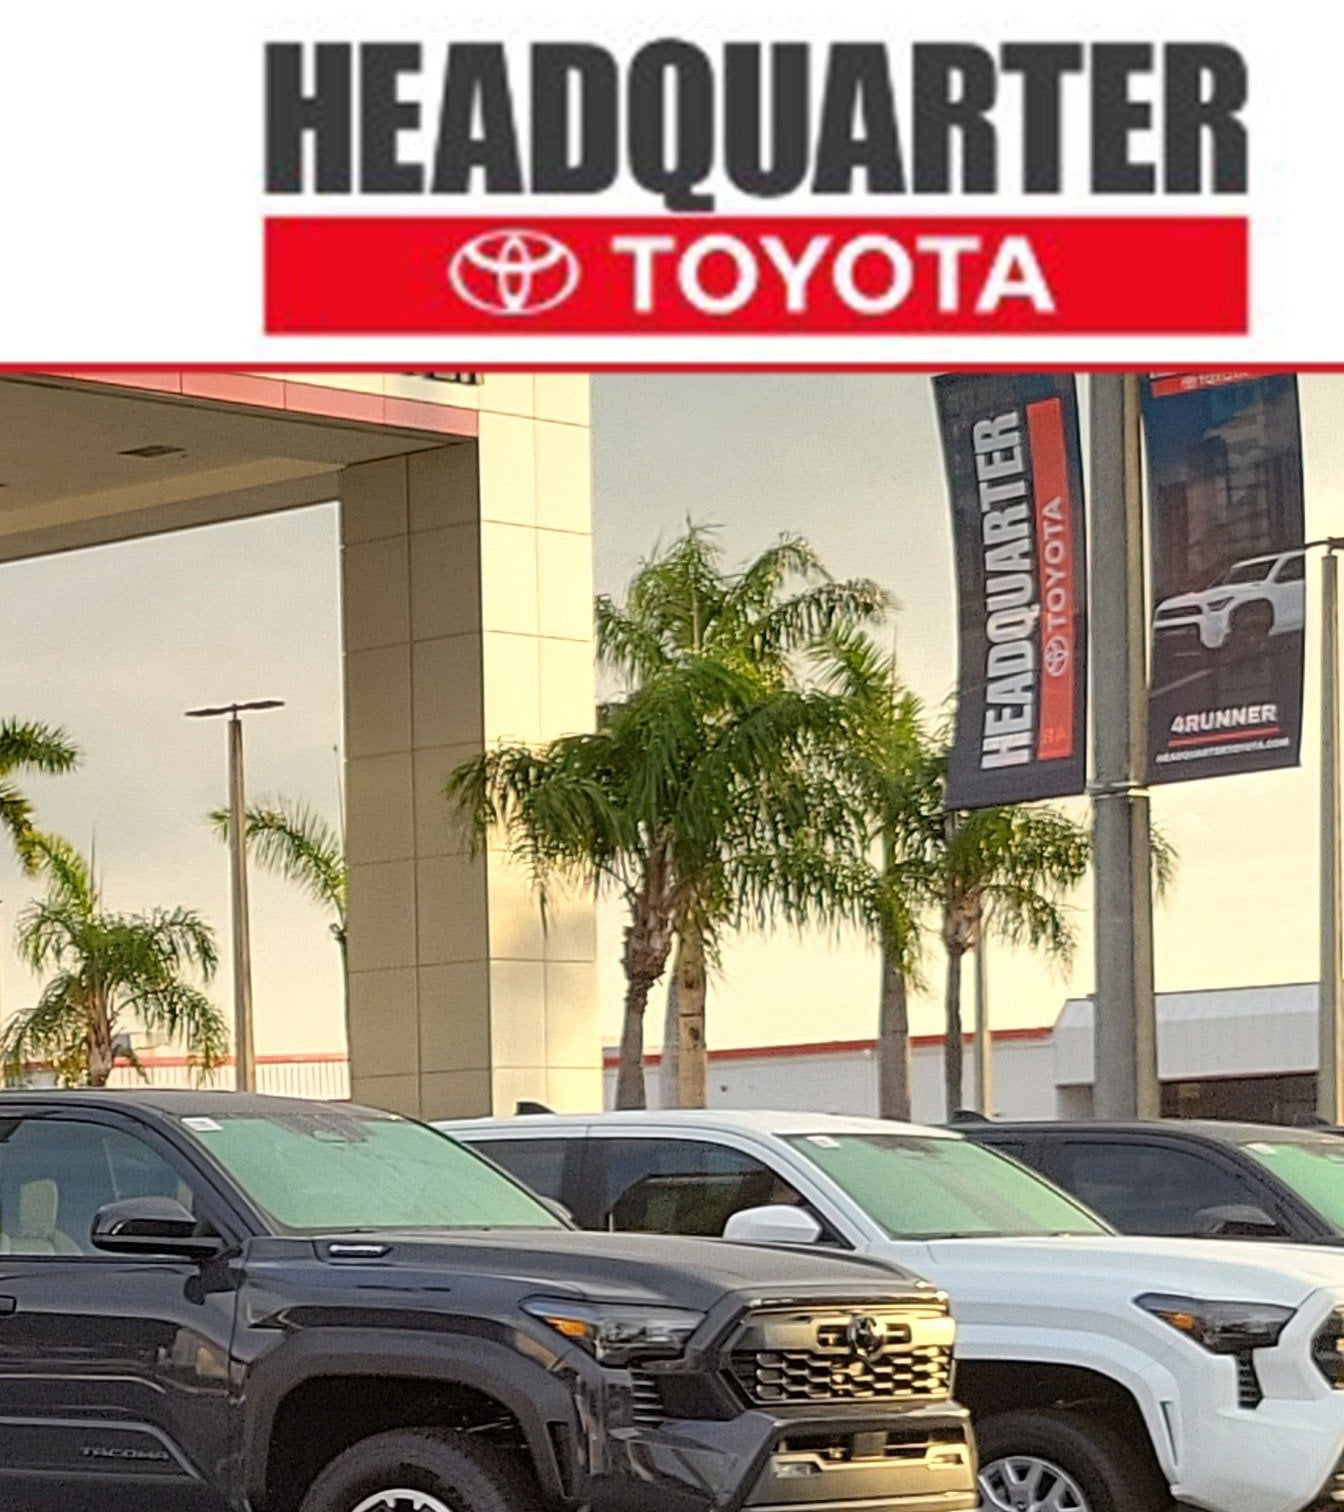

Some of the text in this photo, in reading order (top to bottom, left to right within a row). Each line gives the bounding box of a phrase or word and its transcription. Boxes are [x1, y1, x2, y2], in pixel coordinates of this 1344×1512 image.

[973, 411, 1040, 769] HEADQUARTER
[1043, 496, 1067, 632] TOYOTA
[1170, 704, 1278, 733] 4RUNNER
[80, 1447, 170, 1460] TACOMA
